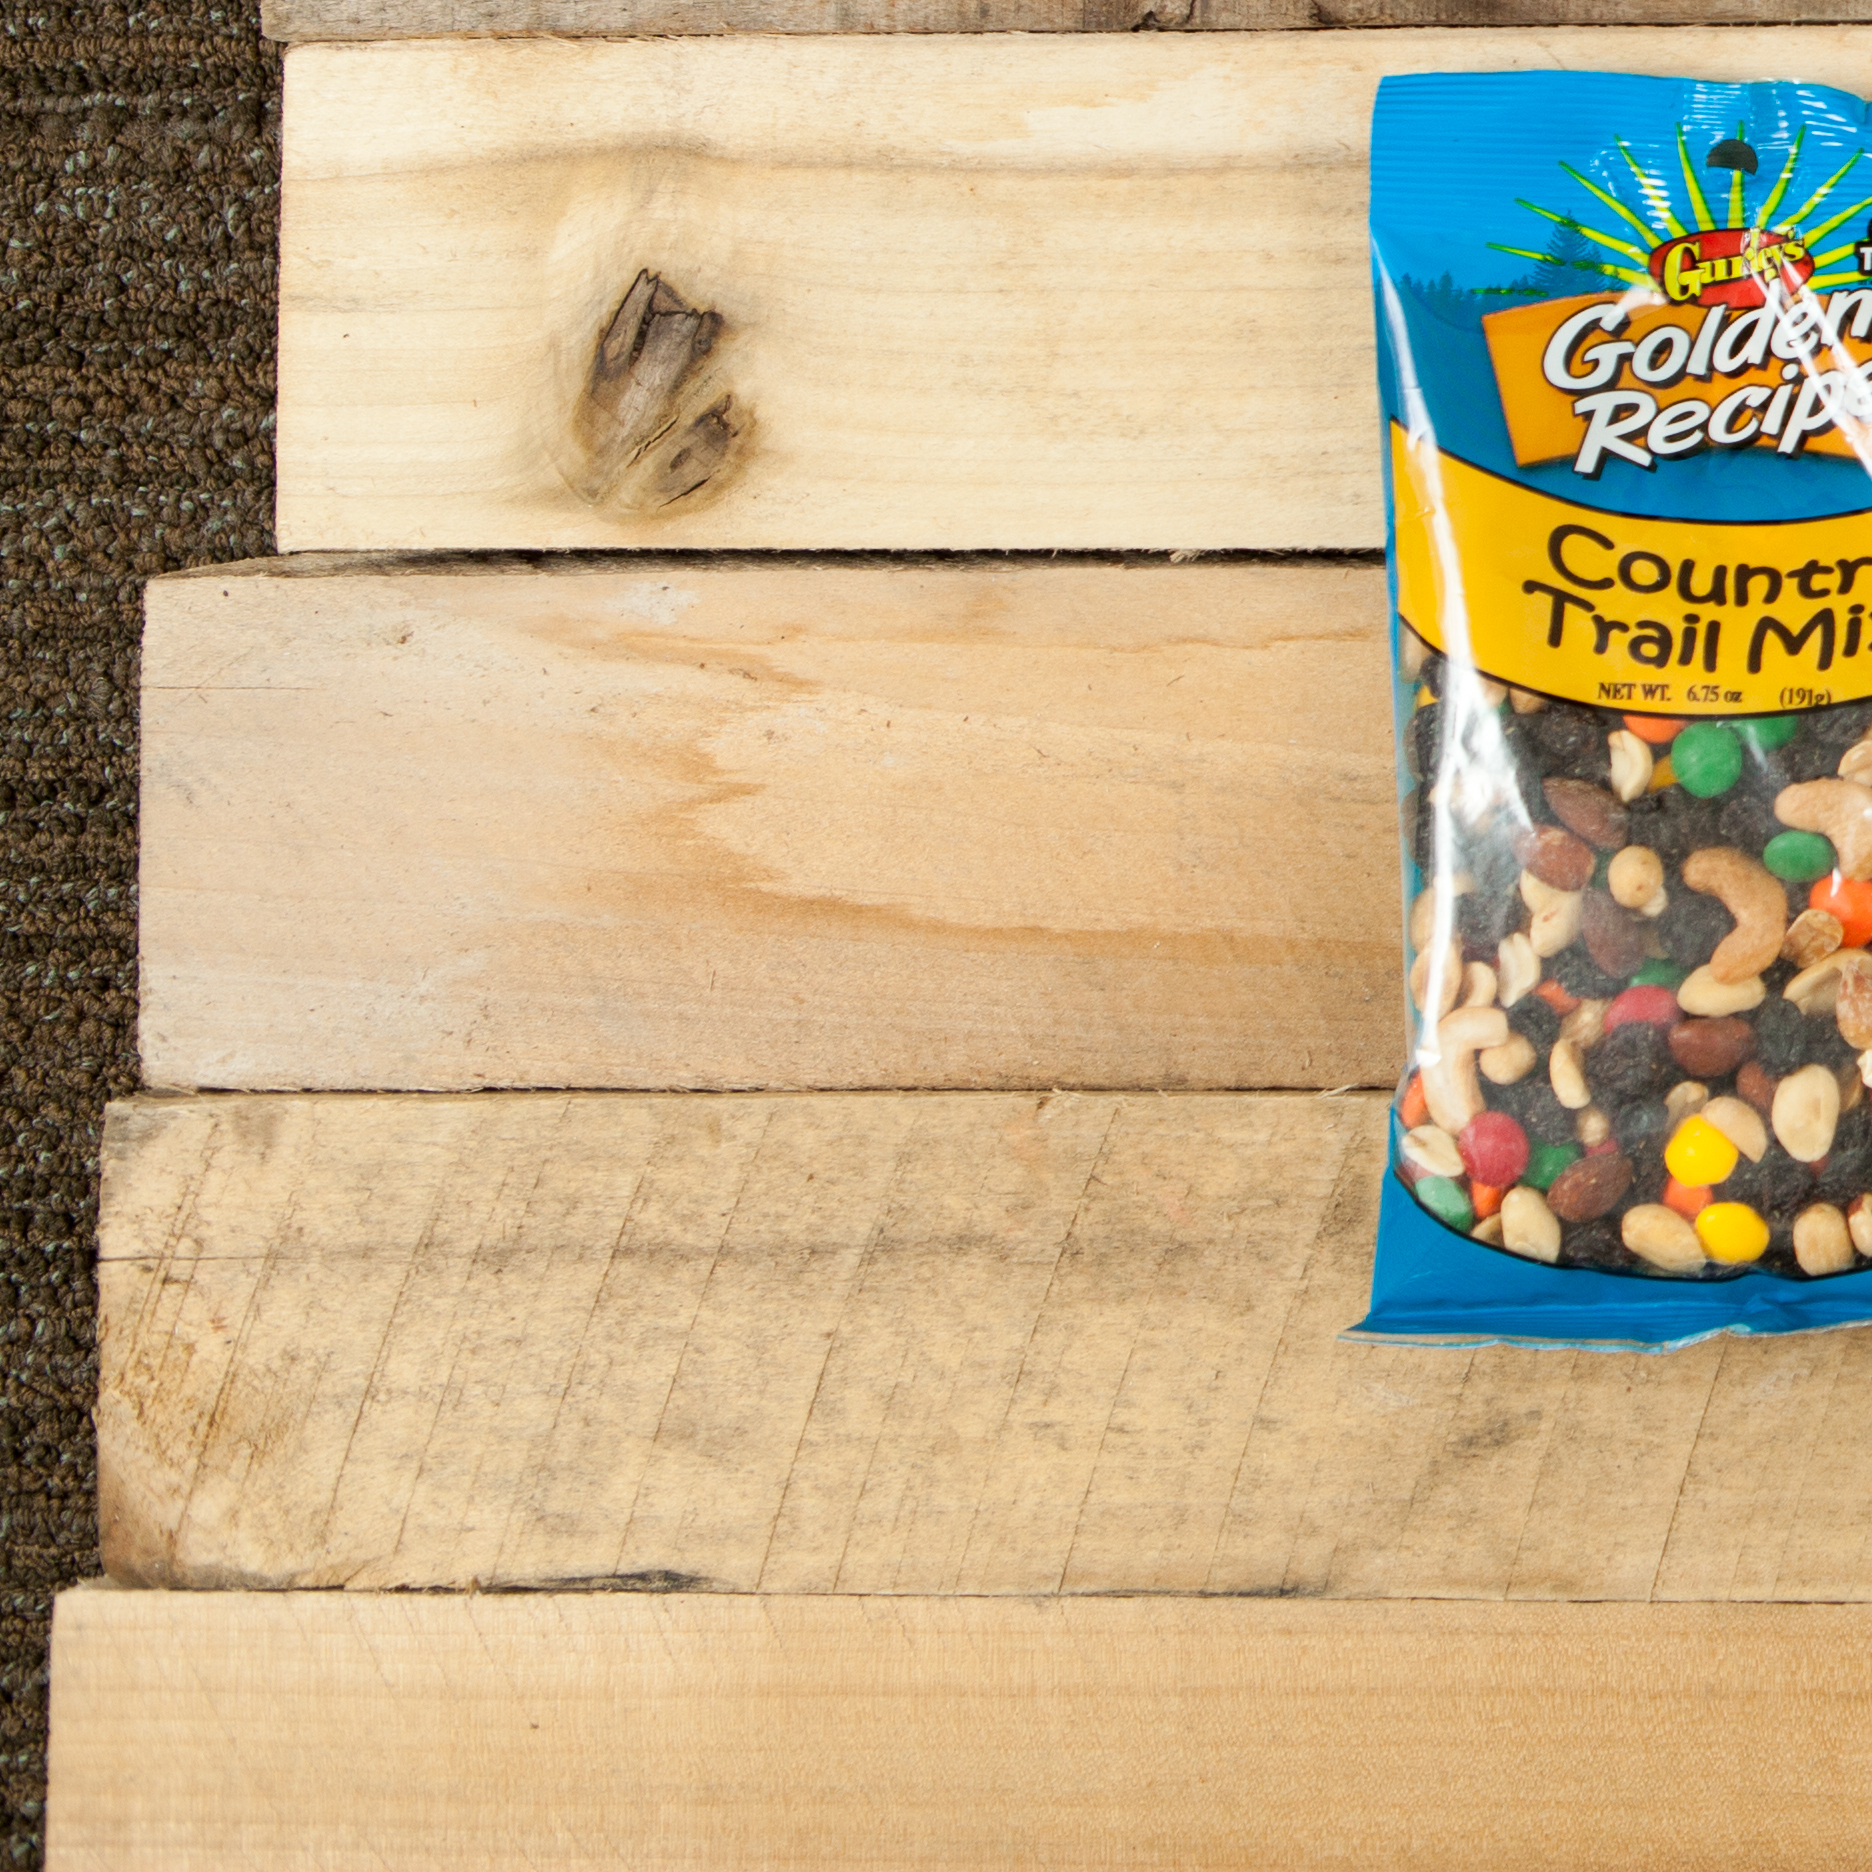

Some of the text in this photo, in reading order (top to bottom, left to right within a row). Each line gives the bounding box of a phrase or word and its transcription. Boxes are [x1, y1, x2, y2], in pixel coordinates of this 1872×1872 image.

[1522, 579, 1721, 673] Trail
[1598, 682, 1832, 707] NET WT. 6.75 oz (191g)
